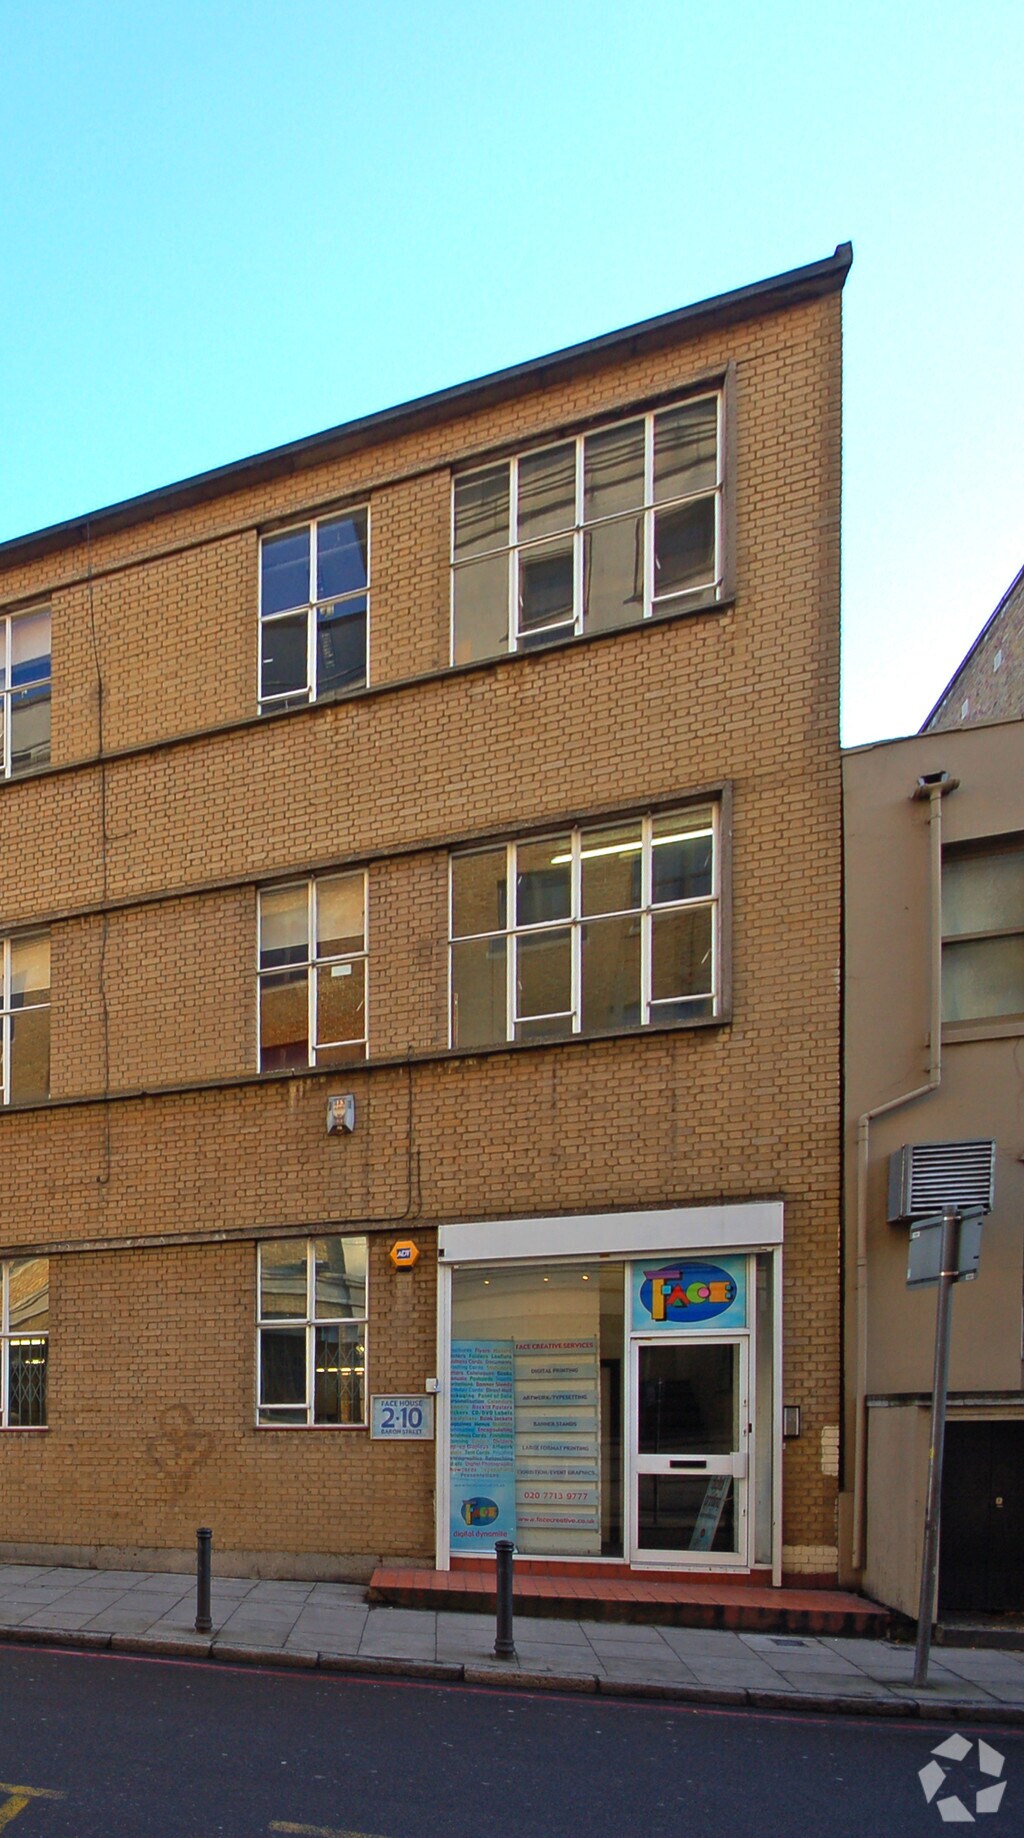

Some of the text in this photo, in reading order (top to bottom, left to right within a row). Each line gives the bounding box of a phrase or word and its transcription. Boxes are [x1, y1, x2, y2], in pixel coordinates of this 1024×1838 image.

[397, 1249, 411, 1258] ADT
[643, 1270, 733, 1321] FACE
[544, 1492, 563, 1500] 7713
[566, 1492, 588, 1500] 9777
[462, 1500, 497, 1526] FACE
[476, 1530, 508, 1538] dynamite
